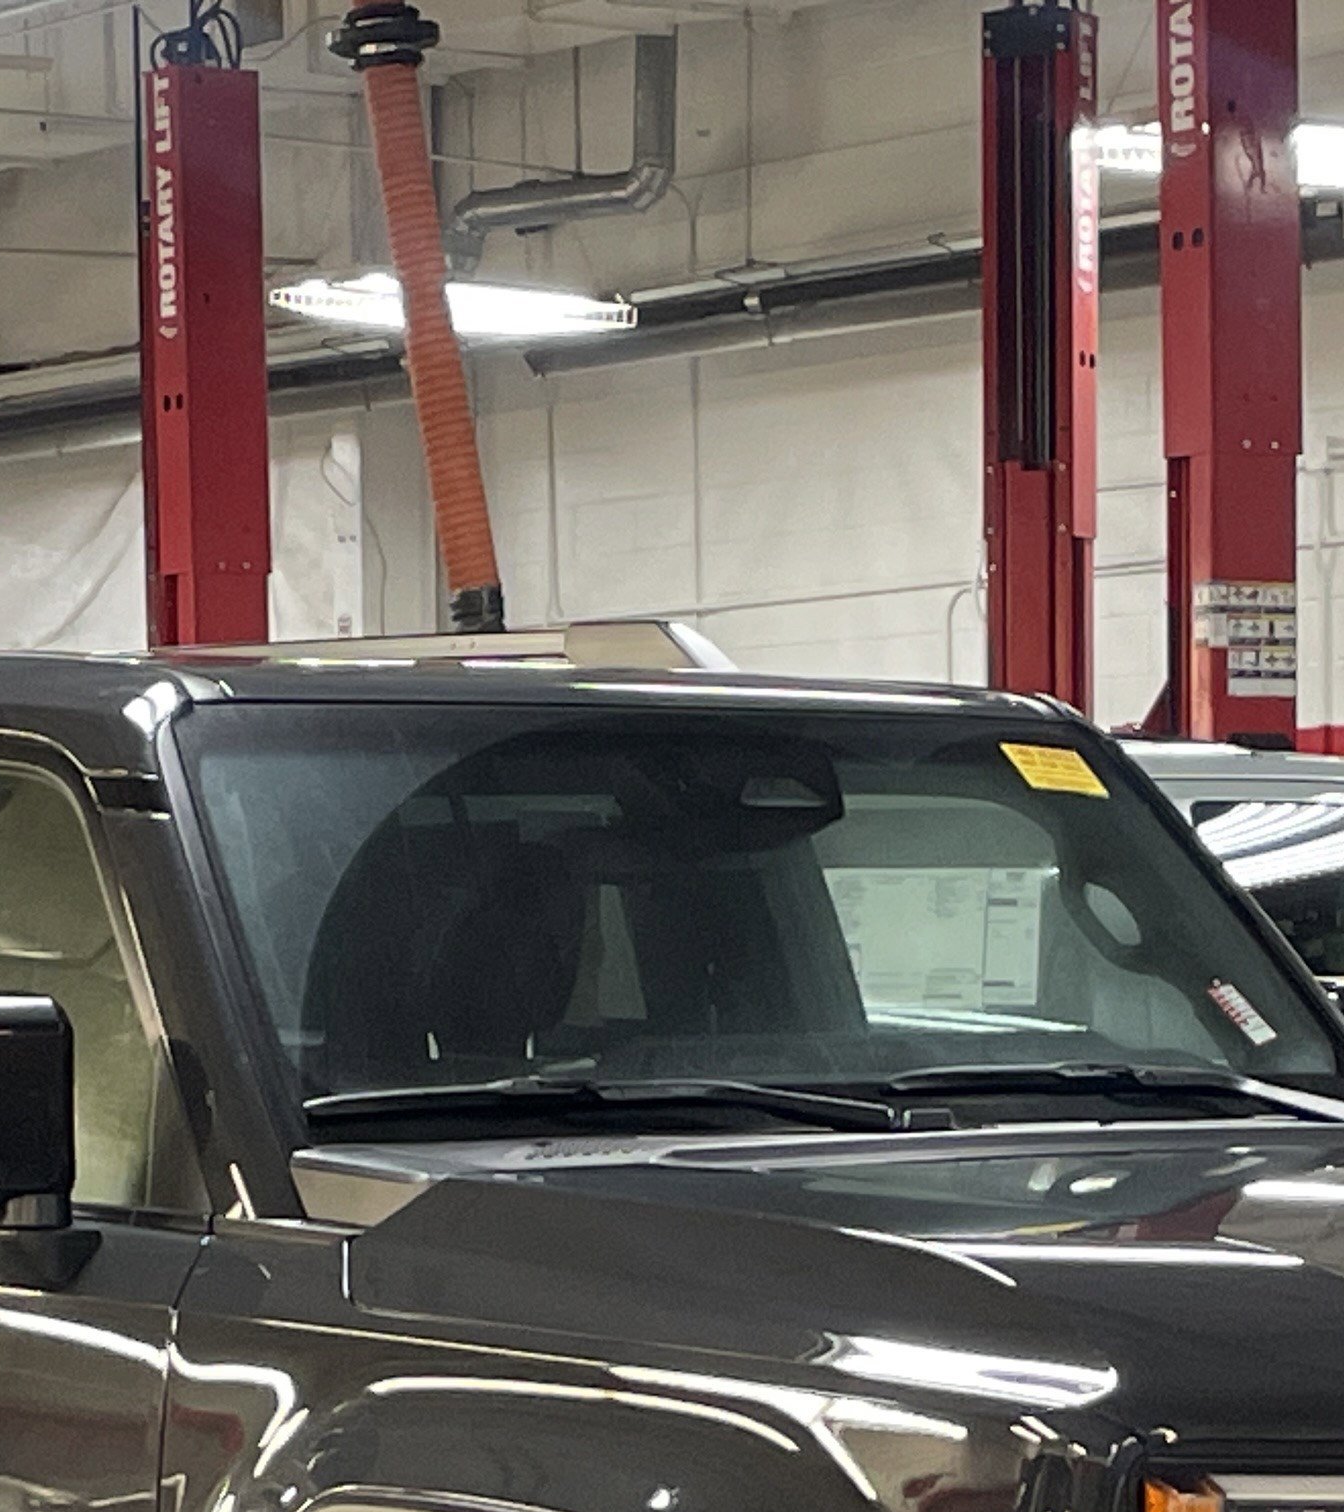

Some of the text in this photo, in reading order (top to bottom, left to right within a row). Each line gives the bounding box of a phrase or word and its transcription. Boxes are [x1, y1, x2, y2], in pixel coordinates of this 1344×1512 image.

[1078, 18, 1093, 100] LIFT
[1169, 0, 1195, 132] ROTA
[154, 70, 177, 318] ROTARY LIFT
